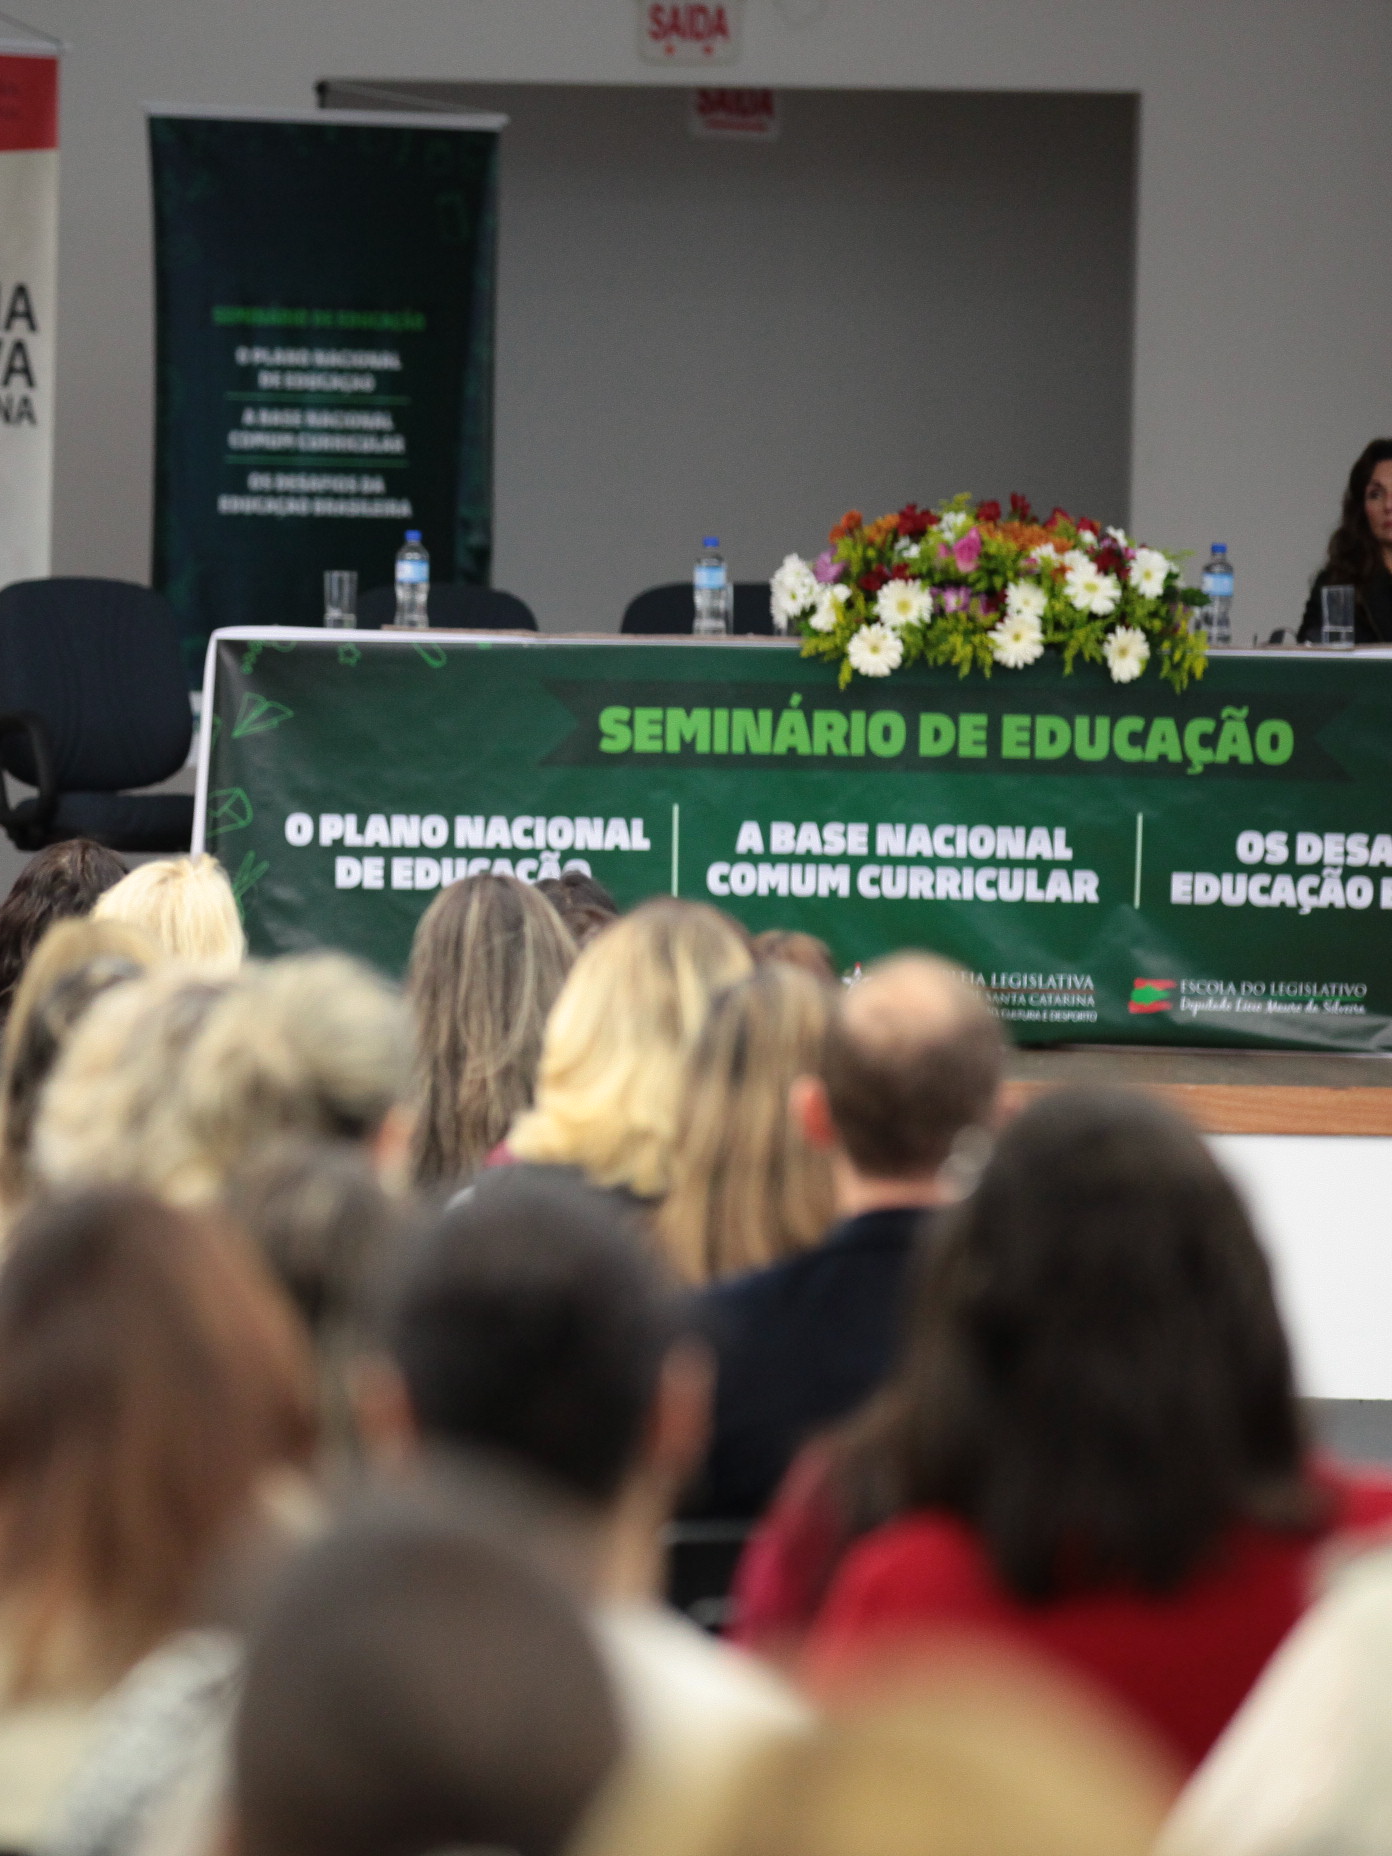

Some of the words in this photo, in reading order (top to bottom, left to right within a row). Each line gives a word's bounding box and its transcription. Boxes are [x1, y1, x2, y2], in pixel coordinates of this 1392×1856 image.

[599, 693, 906, 757] SEMINÁRIO
[918, 712, 987, 758] DE
[1001, 705, 1295, 775] EDUCAÇÃO
[284, 812, 314, 847] O
[319, 813, 450, 848] PLANO
[454, 815, 651, 851] NACIONAL
[735, 820, 765, 855] A
[770, 821, 869, 856] BASE
[876, 823, 1073, 861] NACIONAL
[1235, 829, 1289, 865] OS
[335, 855, 385, 889] DE
[706, 861, 850, 898] COMUM
[856, 865, 1100, 903] CURRICULAR
[1170, 866, 1374, 915] EDUCAÇÃO
[991, 972, 1095, 990] LEGISLATIVA
[1180, 979, 1237, 996] ESCOLA
[1241, 980, 1266, 996] DO
[1270, 981, 1368, 998] LEGISLATIVO
[1030, 993, 1096, 1008] CATARINA
